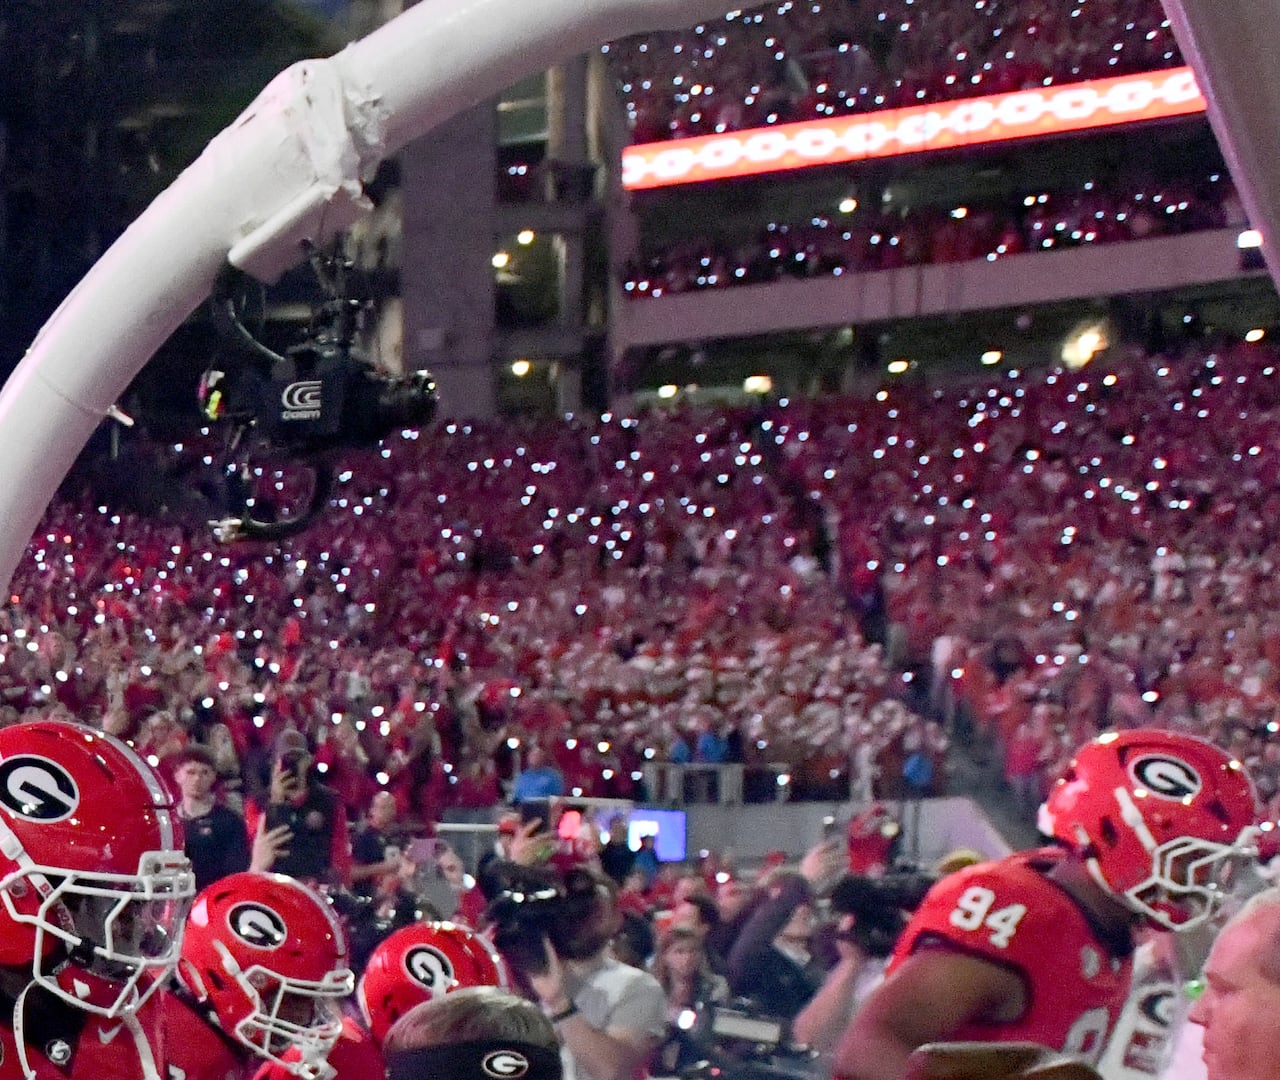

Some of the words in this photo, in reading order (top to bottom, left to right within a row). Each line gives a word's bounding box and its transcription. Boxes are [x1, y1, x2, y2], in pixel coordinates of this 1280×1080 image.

[3, 762, 78, 810] G
[1142, 759, 1198, 794] G
[949, 886, 1027, 949] 94
[491, 1054, 528, 1074] G
